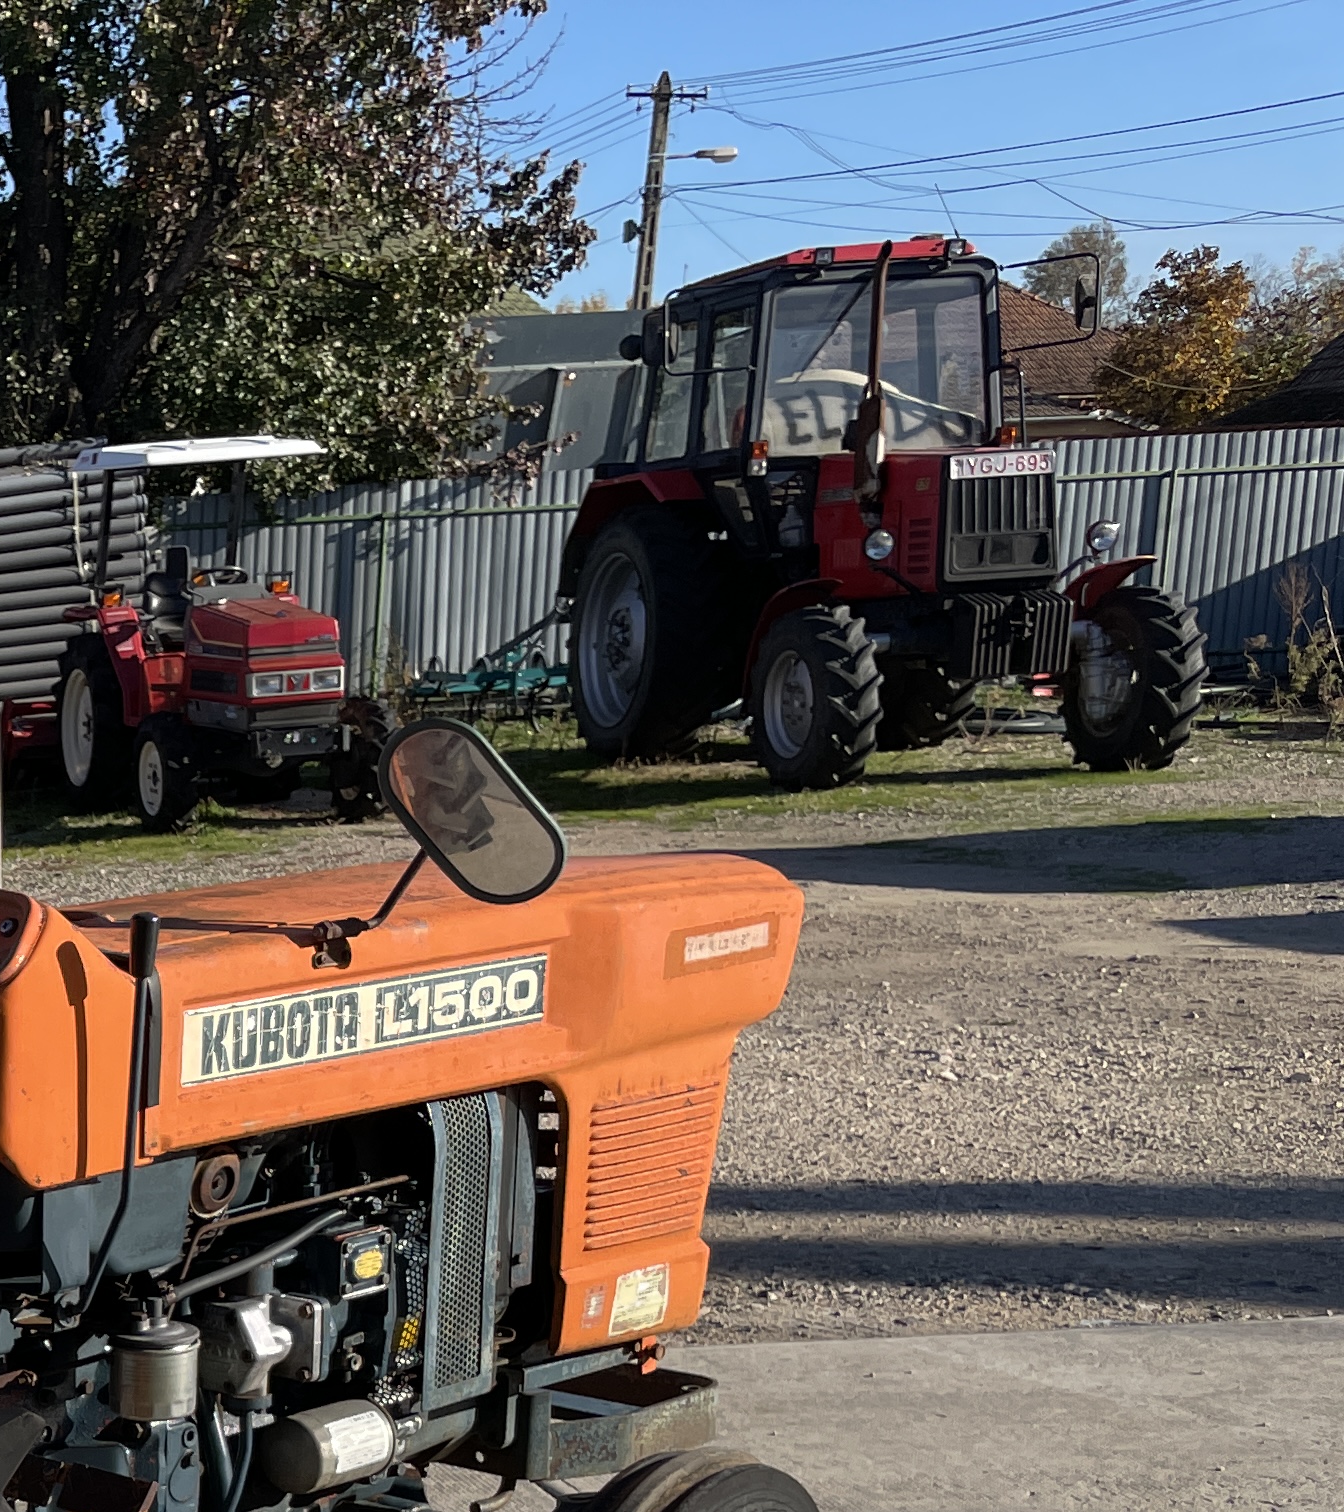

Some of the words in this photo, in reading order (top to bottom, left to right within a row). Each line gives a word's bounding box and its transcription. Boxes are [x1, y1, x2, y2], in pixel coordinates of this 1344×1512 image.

[967, 453, 1050, 476] YGJ-695
[201, 991, 360, 1076] KUBOTA
[382, 969, 538, 1037] L1500
